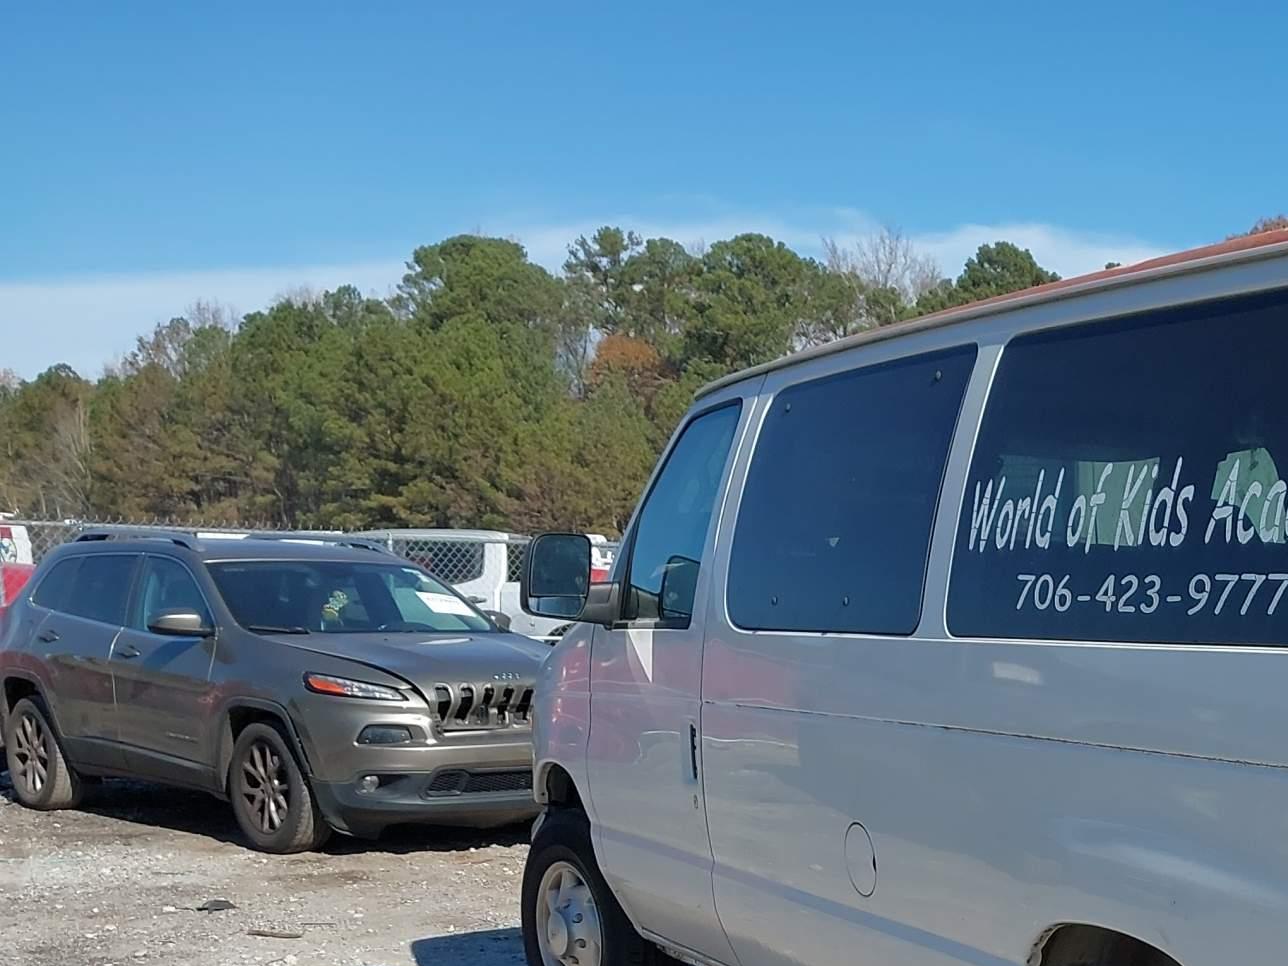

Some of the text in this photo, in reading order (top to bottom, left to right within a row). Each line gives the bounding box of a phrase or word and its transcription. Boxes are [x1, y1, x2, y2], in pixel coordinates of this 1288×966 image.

[968, 467, 1065, 553] World
[1066, 462, 1113, 554] of
[1113, 457, 1195, 552] Kids
